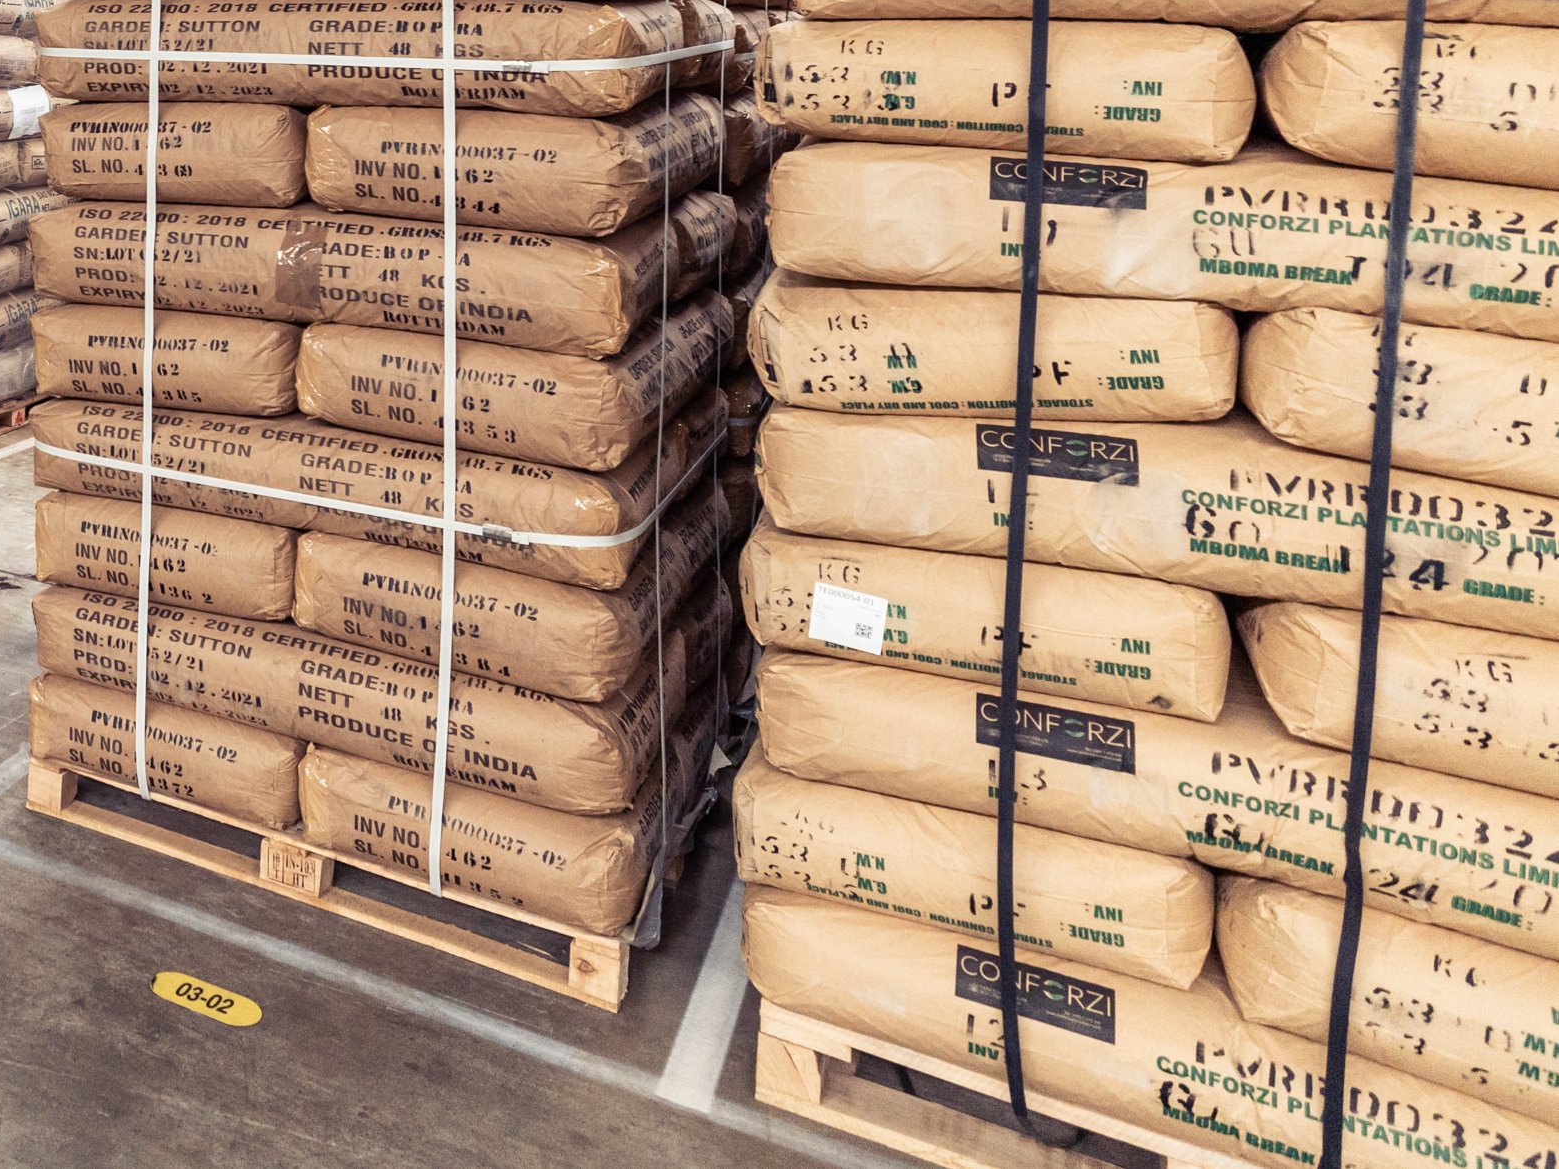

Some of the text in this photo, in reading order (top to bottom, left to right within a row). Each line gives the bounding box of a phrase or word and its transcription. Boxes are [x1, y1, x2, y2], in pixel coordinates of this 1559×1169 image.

[88, 2, 564, 14] ISO 2018 CERTIFIED KGS
[179, 21, 260, 33] SUTTON
[308, 42, 411, 55] NETT 48
[308, 65, 547, 83] PRODUCE INDIA
[830, 114, 863, 124] PLACE
[72, 139, 96, 151] INV
[355, 161, 385, 177] INV
[5, 196, 40, 219] IGARA
[79, 209, 552, 248] ISO 2018 KGS
[1193, 210, 1319, 234] CONFORZI
[167, 233, 249, 249] SUTTON
[1200, 257, 1352, 285] MBOMA BREAK
[460, 302, 533, 323] INDIA
[69, 359, 92, 374] INV
[351, 376, 382, 395] INV
[841, 400, 874, 409] PLACE
[82, 406, 553, 481] ISO 2018 CERTIFIED KGS
[169, 435, 252, 457] SUTTON
[299, 477, 401, 505] NETT 48
[1181, 490, 1500, 548] CONFORZI PLATATIONS
[75, 543, 101, 560] INV
[1190, 538, 1269, 562] MBOMA
[82, 593, 381, 667] ISO 2018 CERTIFIED
[169, 629, 252, 659] SUTTON
[299, 683, 353, 708] NETT
[69, 727, 95, 747] INV
[299, 707, 538, 780] PRODUCE INDIA
[1178, 782, 1300, 821] CONFORZI
[354, 814, 385, 836] INV
[175, 982, 234, 1014] 03-02
[1156, 1056, 1278, 1109] CONFORZI
[1246, 1135, 1315, 1166] BREAK
